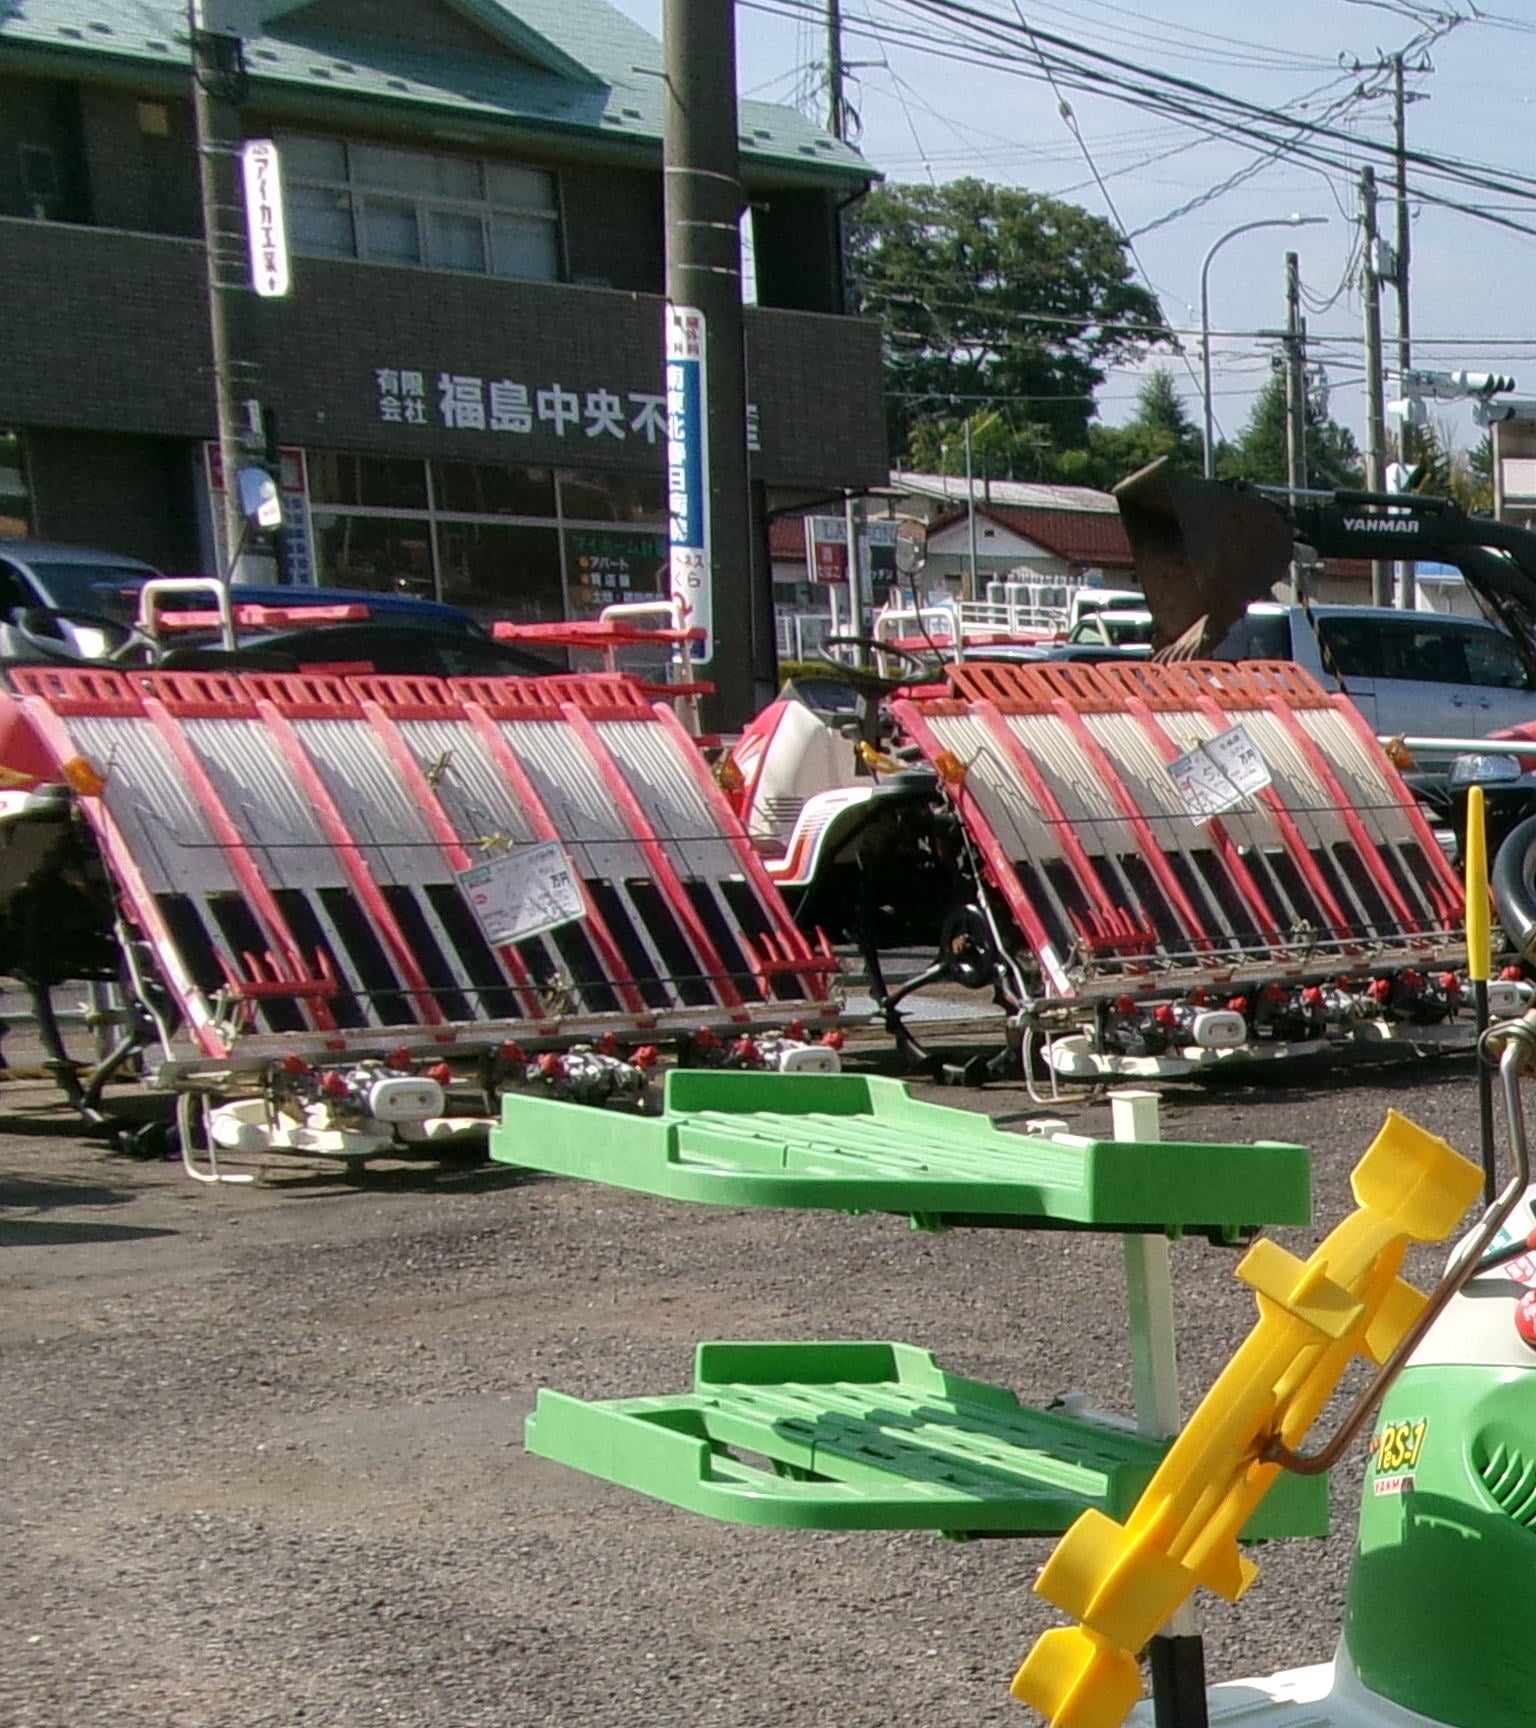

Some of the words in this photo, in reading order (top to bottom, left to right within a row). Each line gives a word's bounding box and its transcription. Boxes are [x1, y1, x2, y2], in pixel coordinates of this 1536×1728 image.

[375, 369, 425, 397] 有限
[379, 396, 428, 425] 会社
[1343, 518, 1420, 534] YANMAR
[590, 556, 630, 571] アパート
[550, 871, 571, 888] 万円
